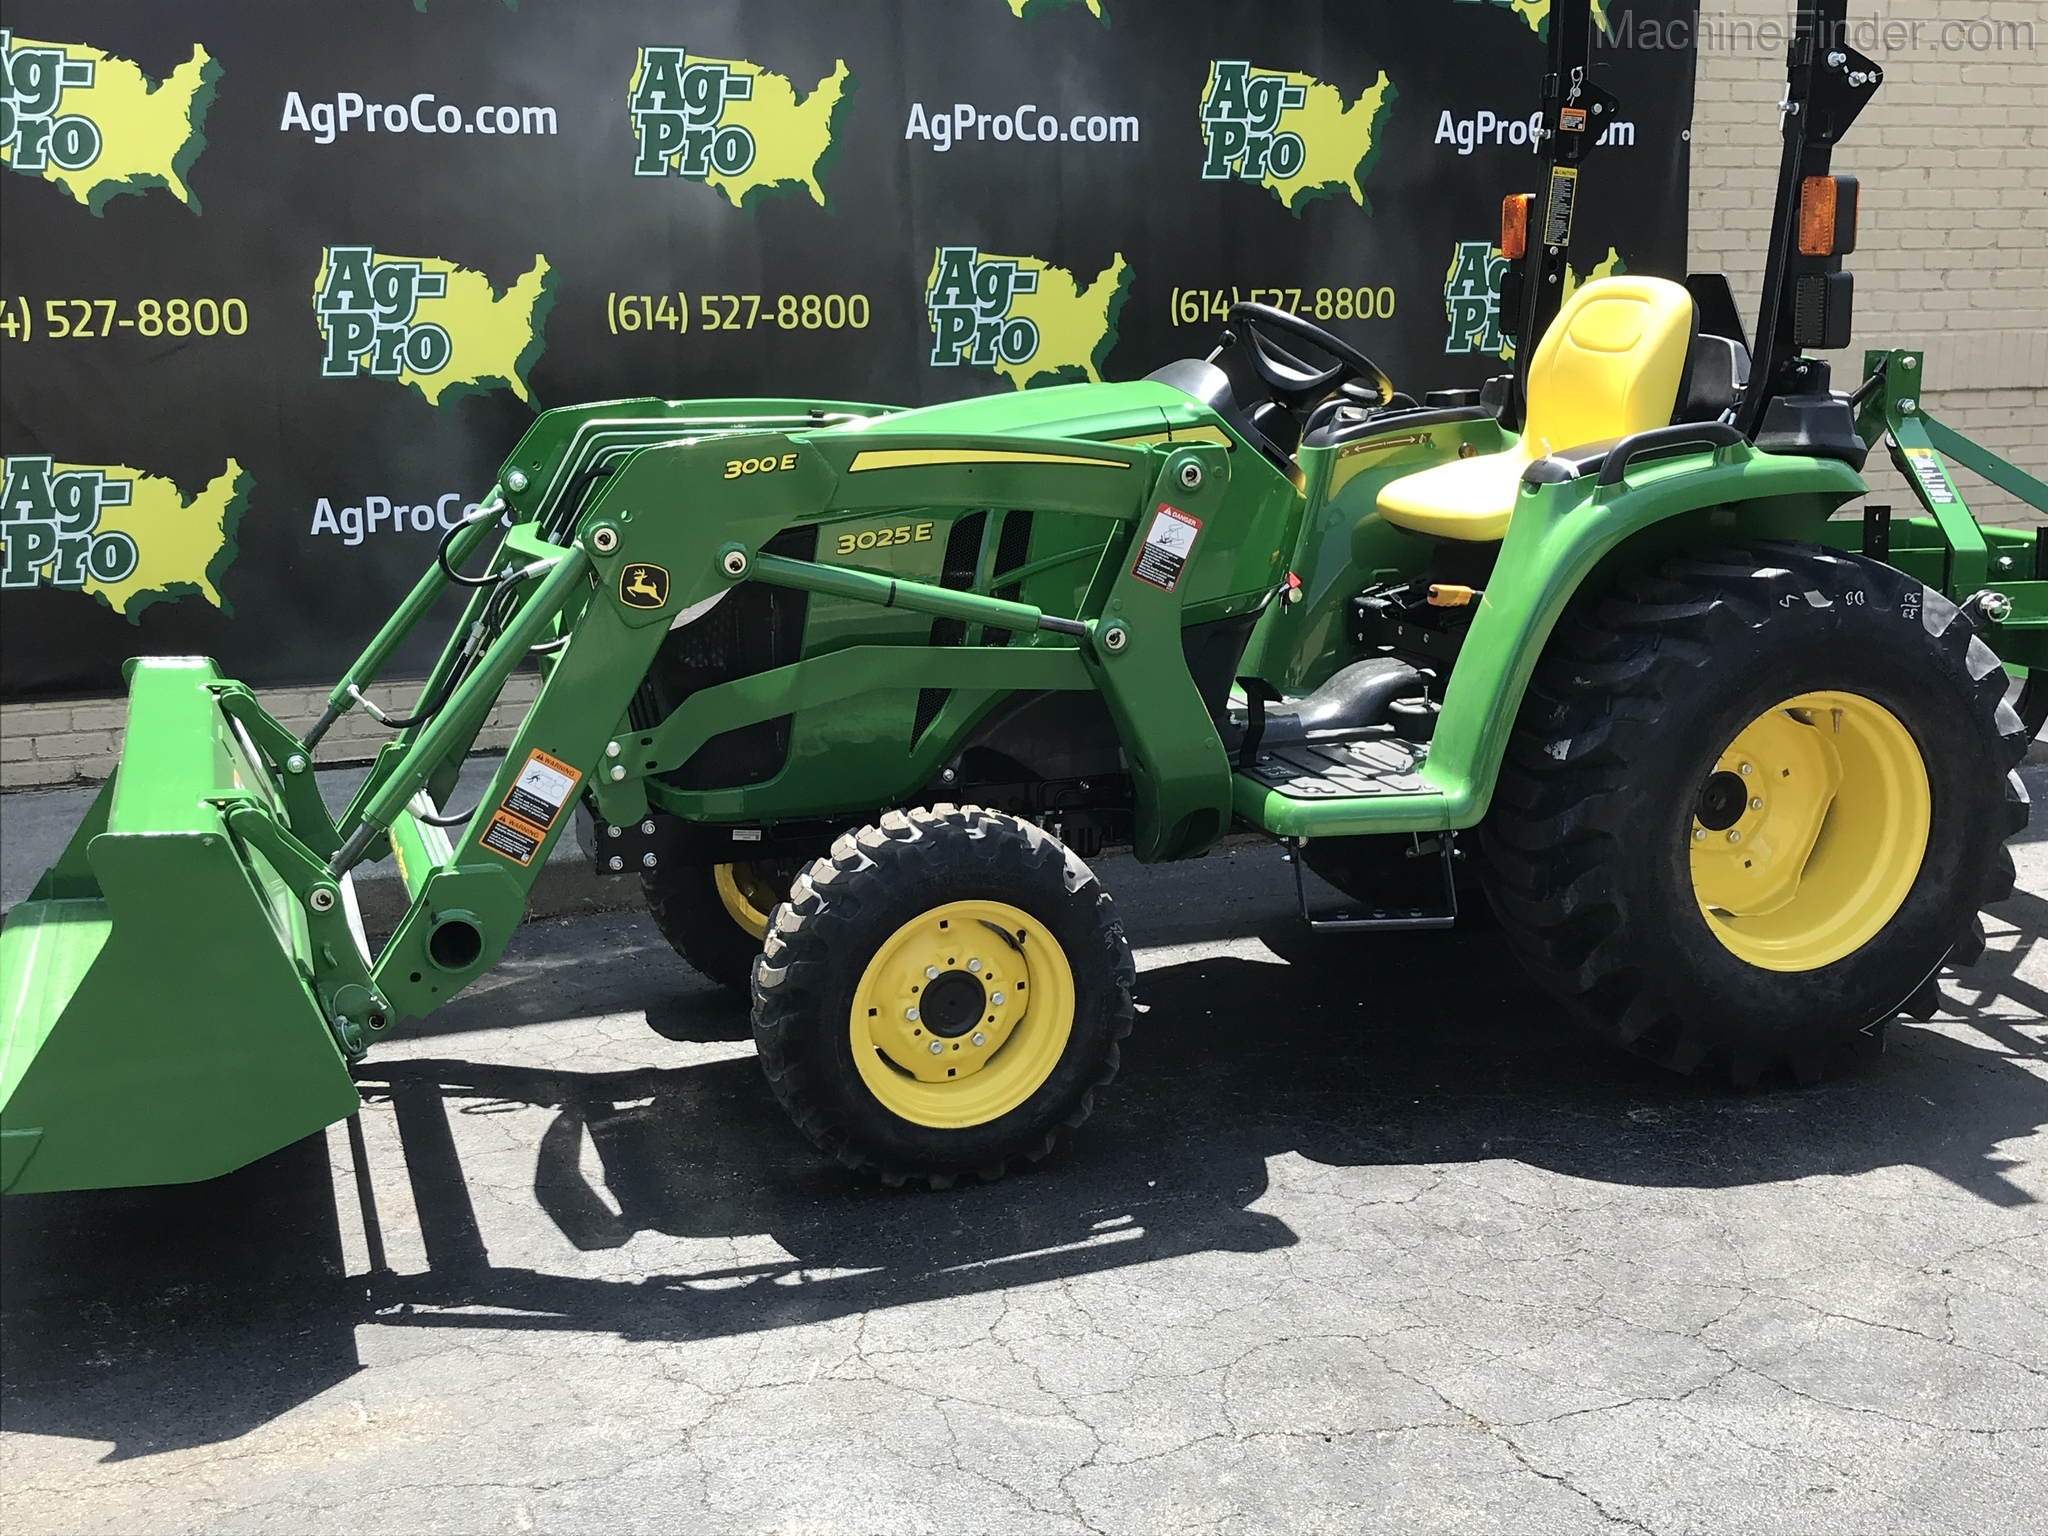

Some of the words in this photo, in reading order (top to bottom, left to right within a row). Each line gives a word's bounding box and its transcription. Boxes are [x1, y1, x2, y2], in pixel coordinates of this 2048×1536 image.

[631, 47, 752, 128] Ag-
[1202, 61, 1306, 134] Ag-
[280, 91, 558, 144] AgProCo.com
[634, 111, 754, 176] Pro
[905, 103, 1139, 151] AgProCo.com
[1202, 120, 1306, 179] Pro
[317, 246, 446, 327] Ag-
[607, 292, 689, 334] (614)
[701, 294, 870, 330] 527-8800
[928, 246, 1038, 321] Ag-
[45, 298, 248, 338] 527-8800
[322, 311, 452, 377] Pro
[930, 307, 1039, 366] Pro
[0, 456, 131, 537] Ag-
[1172, 510, 1197, 527] DANGER
[0, 519, 137, 587] Pro
[544, 757, 575, 777] WARNING
[508, 819, 540, 838] WARNING
